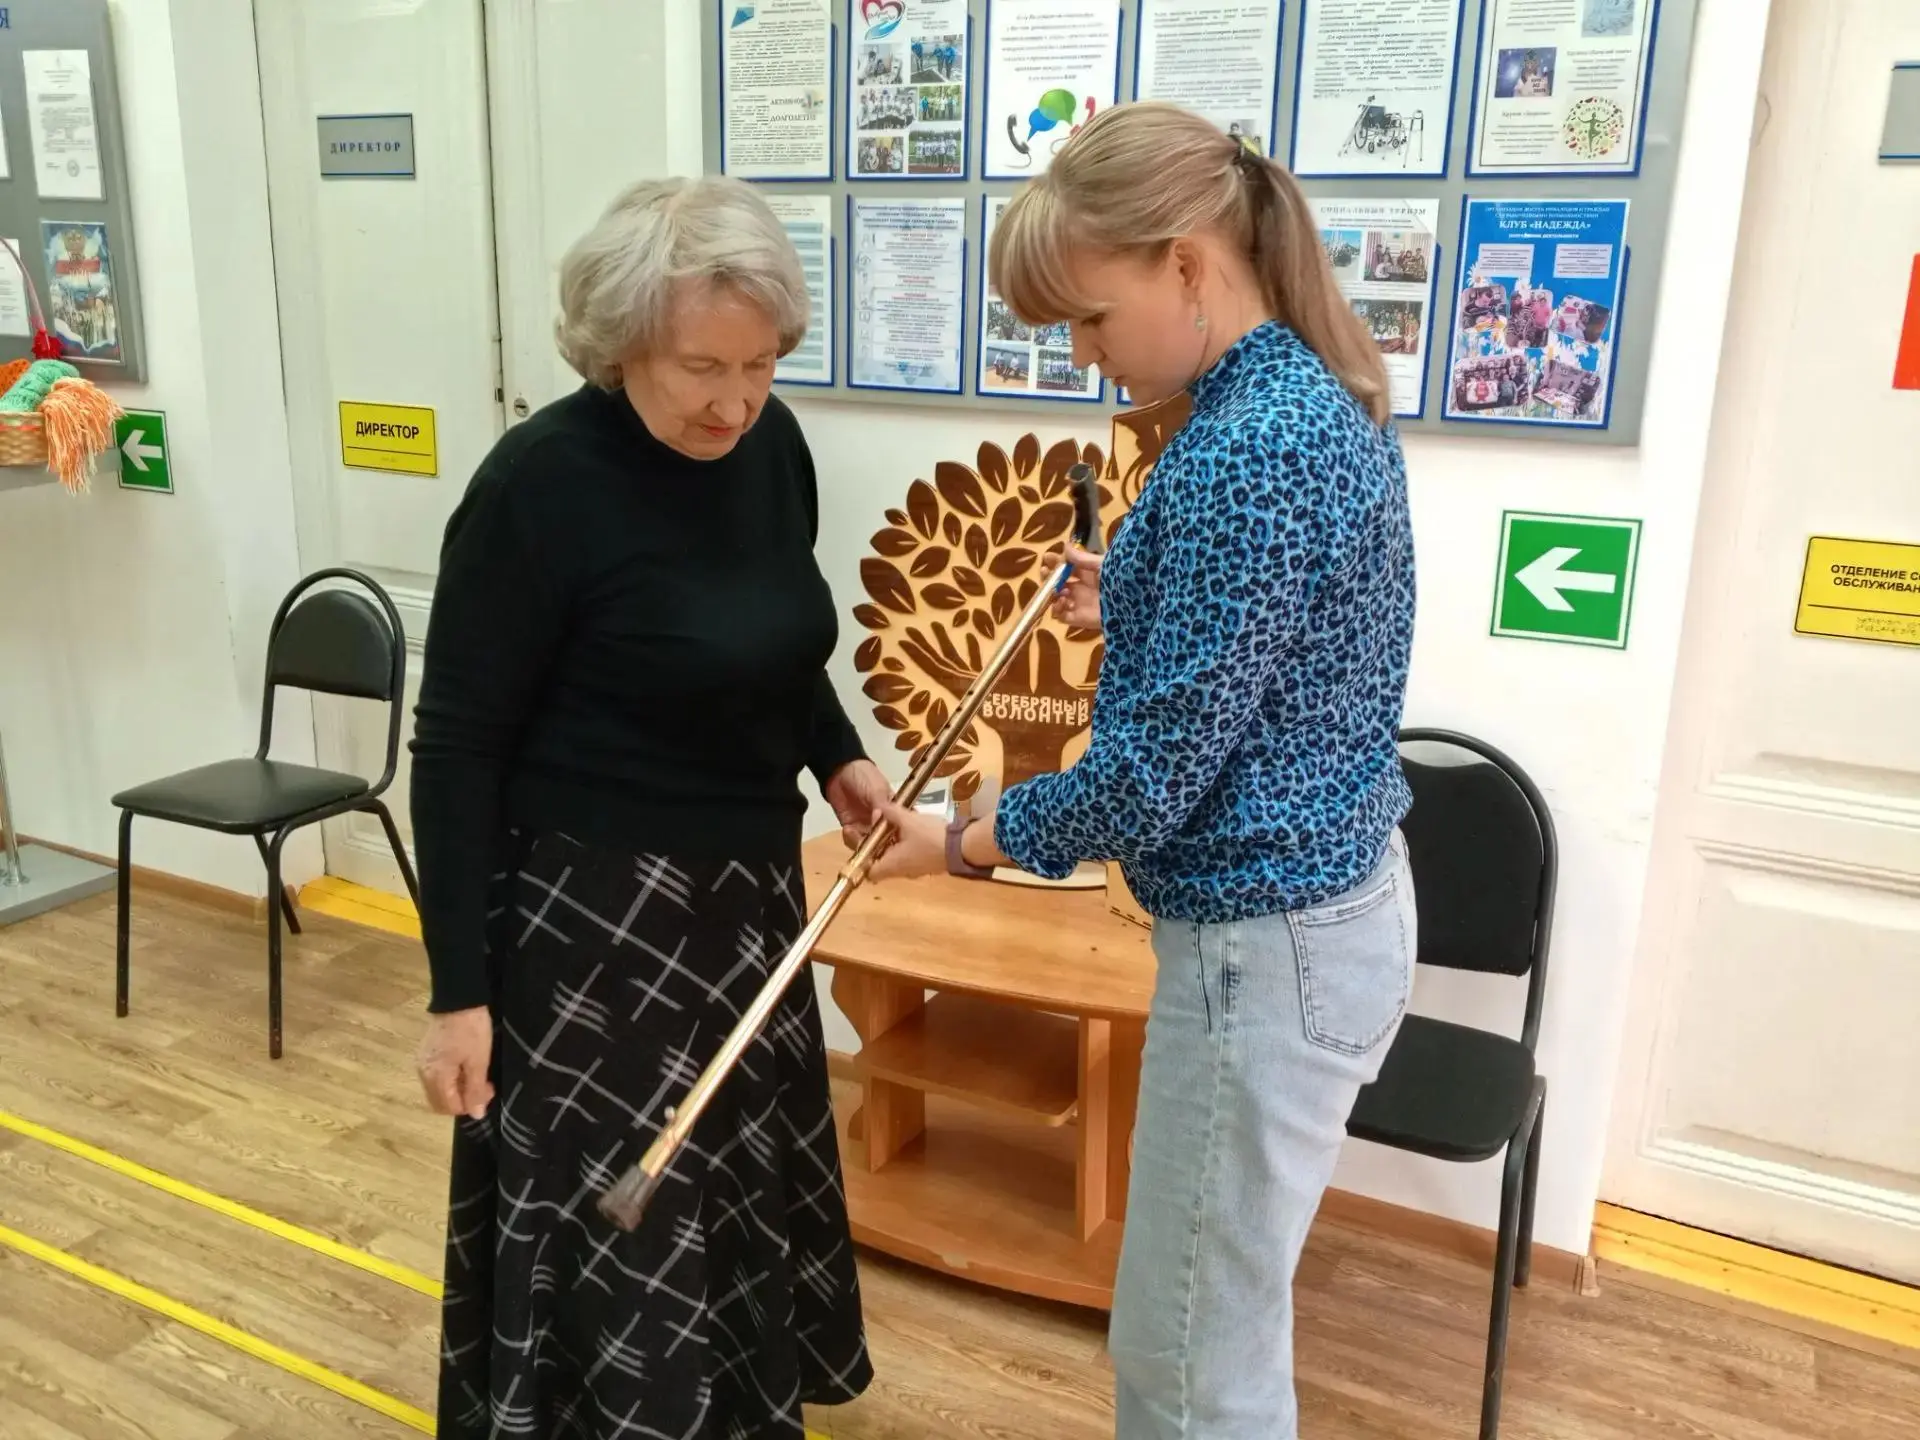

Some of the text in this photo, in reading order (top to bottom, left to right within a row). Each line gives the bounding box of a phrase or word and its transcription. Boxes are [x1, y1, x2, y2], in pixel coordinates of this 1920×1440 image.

[330, 141, 401, 154] ДИРЕКТОР
[1499, 220, 1591, 230] КЛУБ «НАДЕЖДА»
[356, 421, 419, 439] ДИРЕКТОР
[1831, 564, 1920, 581] ОТДЕЛЕНИЕ С
[986, 693, 1089, 716] ЕРЕБРЯНЫЙ
[983, 701, 1089, 726] ВОЛОНТЕР
